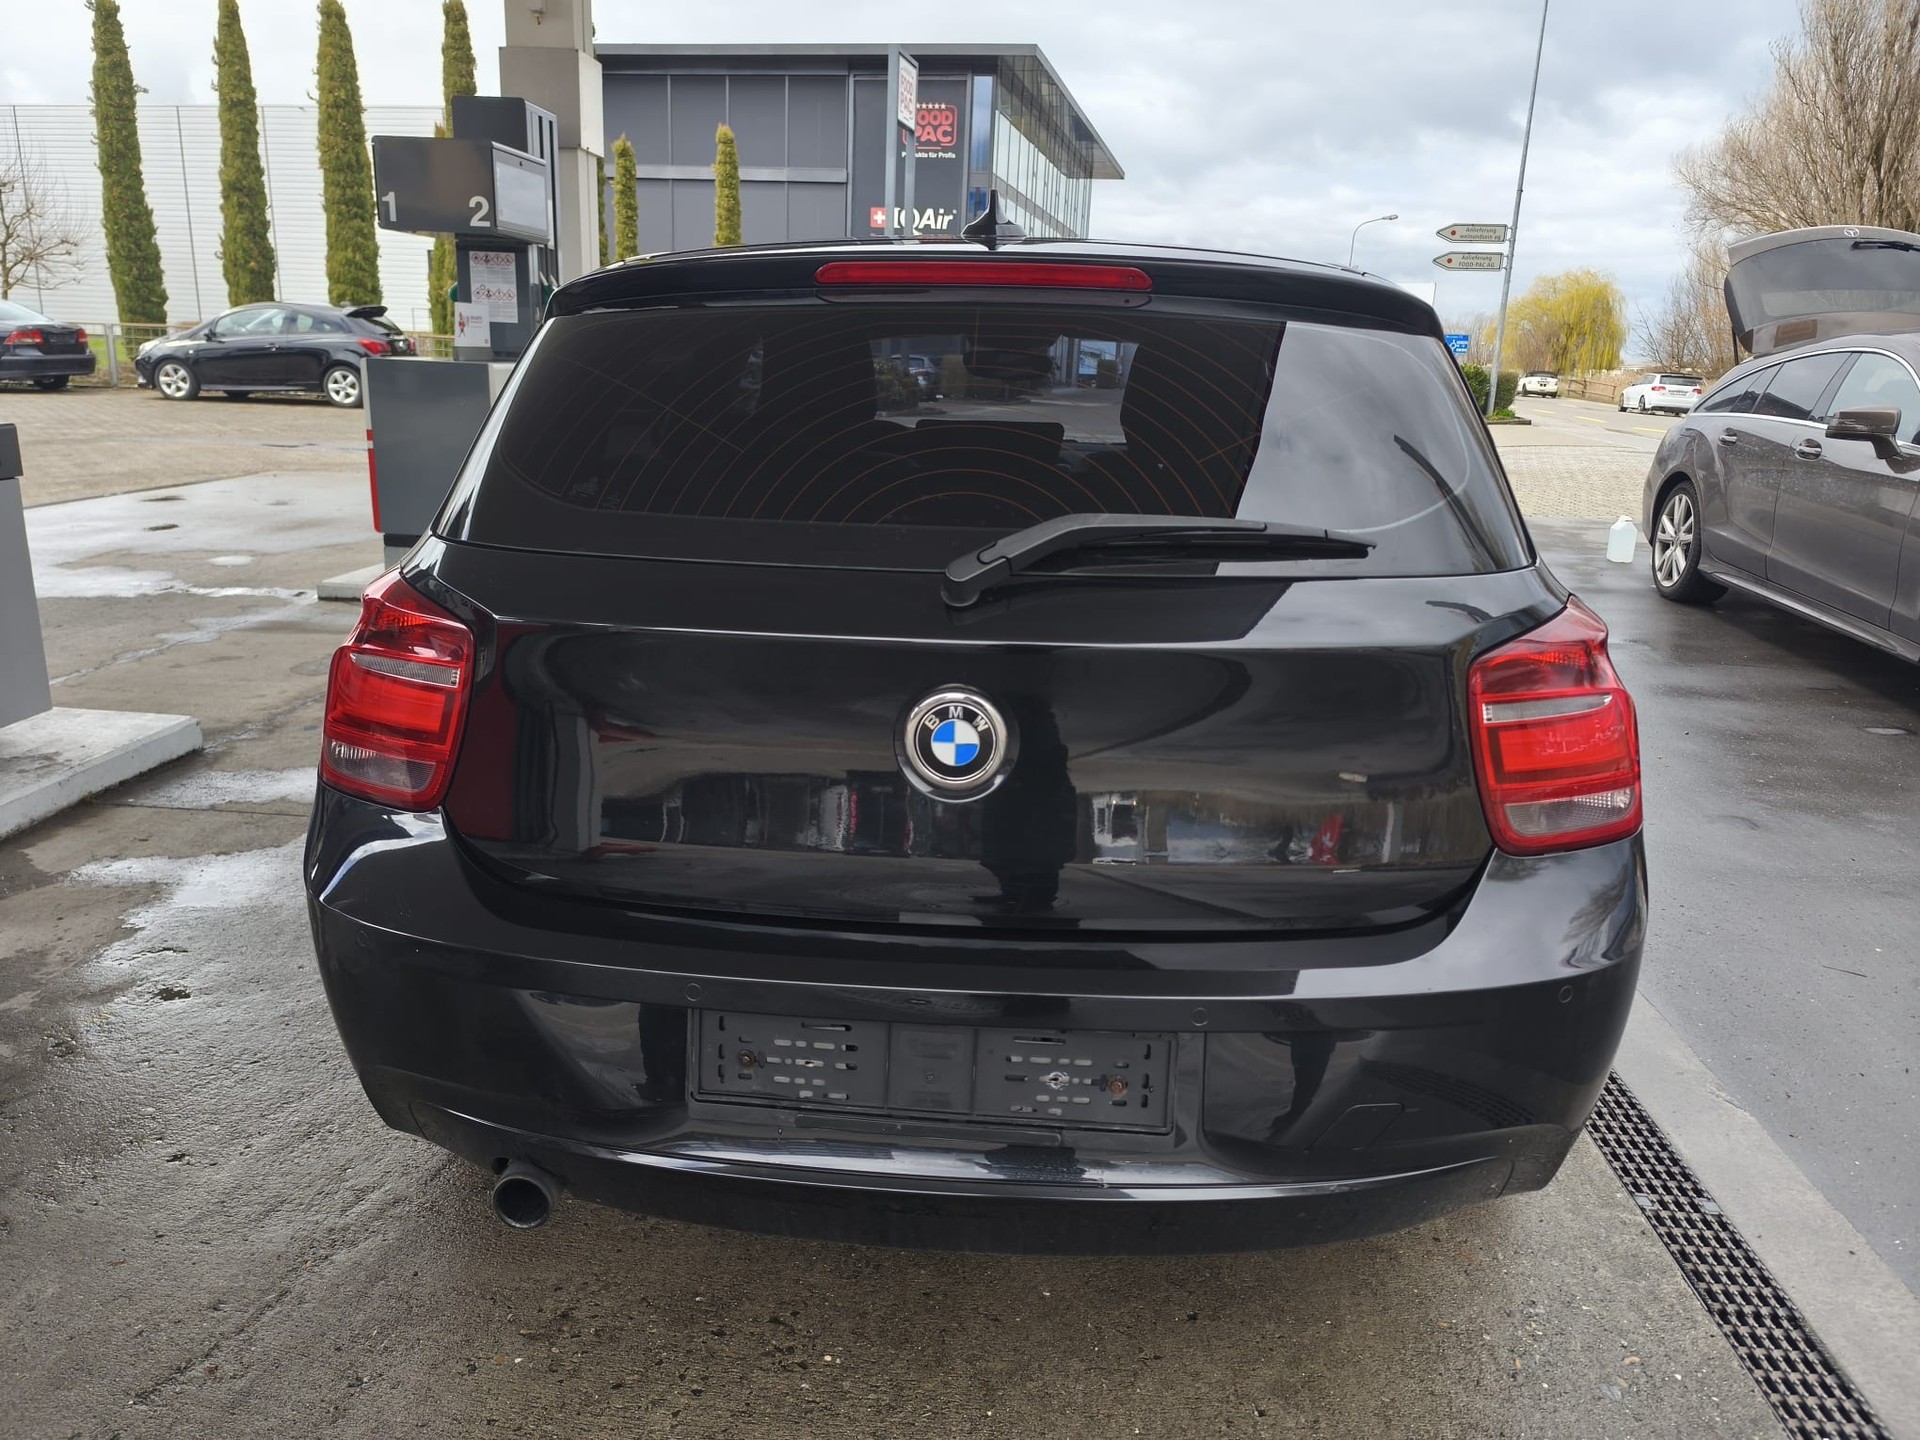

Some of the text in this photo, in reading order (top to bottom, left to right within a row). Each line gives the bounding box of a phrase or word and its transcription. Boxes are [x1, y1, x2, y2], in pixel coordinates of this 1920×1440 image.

[917, 110, 953, 126] OOD
[381, 191, 397, 222] 1
[468, 195, 491, 227] 2
[924, 706, 989, 732] BMW
